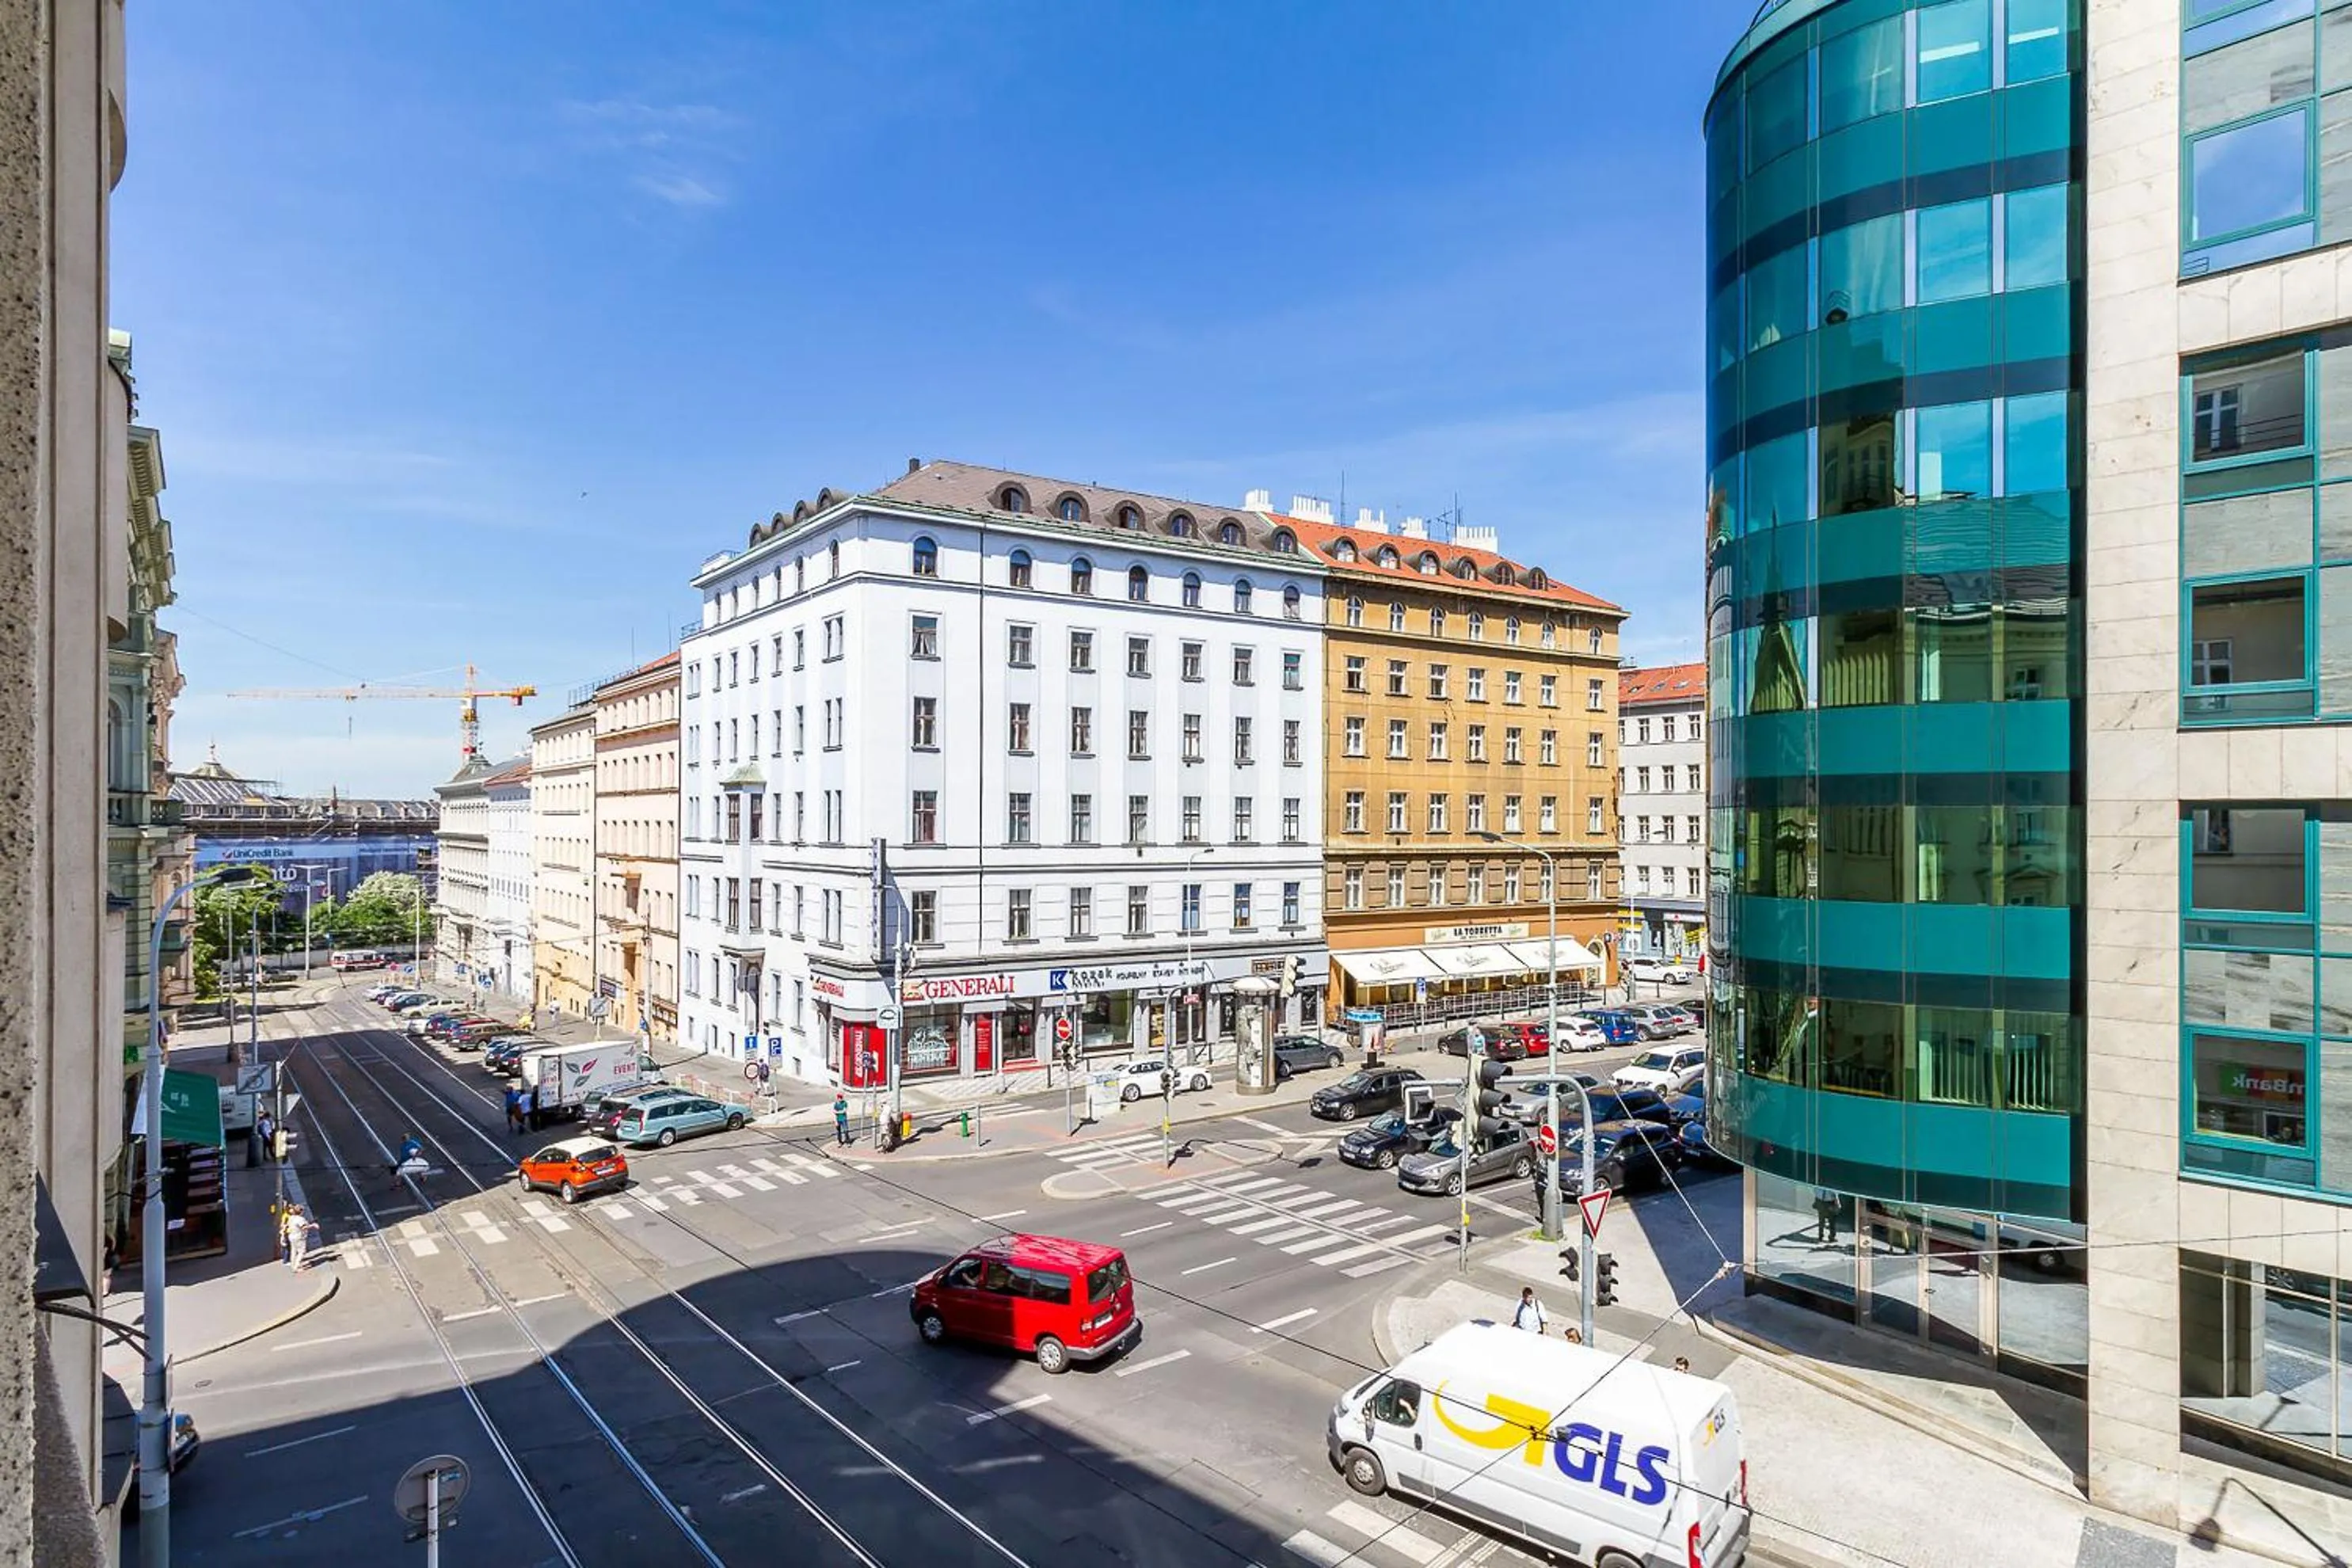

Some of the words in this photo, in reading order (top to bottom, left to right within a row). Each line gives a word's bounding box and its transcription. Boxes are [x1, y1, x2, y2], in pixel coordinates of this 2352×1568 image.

[233, 848, 272, 858] UniCredit
[273, 847, 293, 857] Bank
[1464, 925, 1503, 935] TORRETTA
[924, 976, 1015, 999] GENERALI
[614, 1063, 637, 1075] EVENT
[1553, 1421, 1671, 1506] GLS
